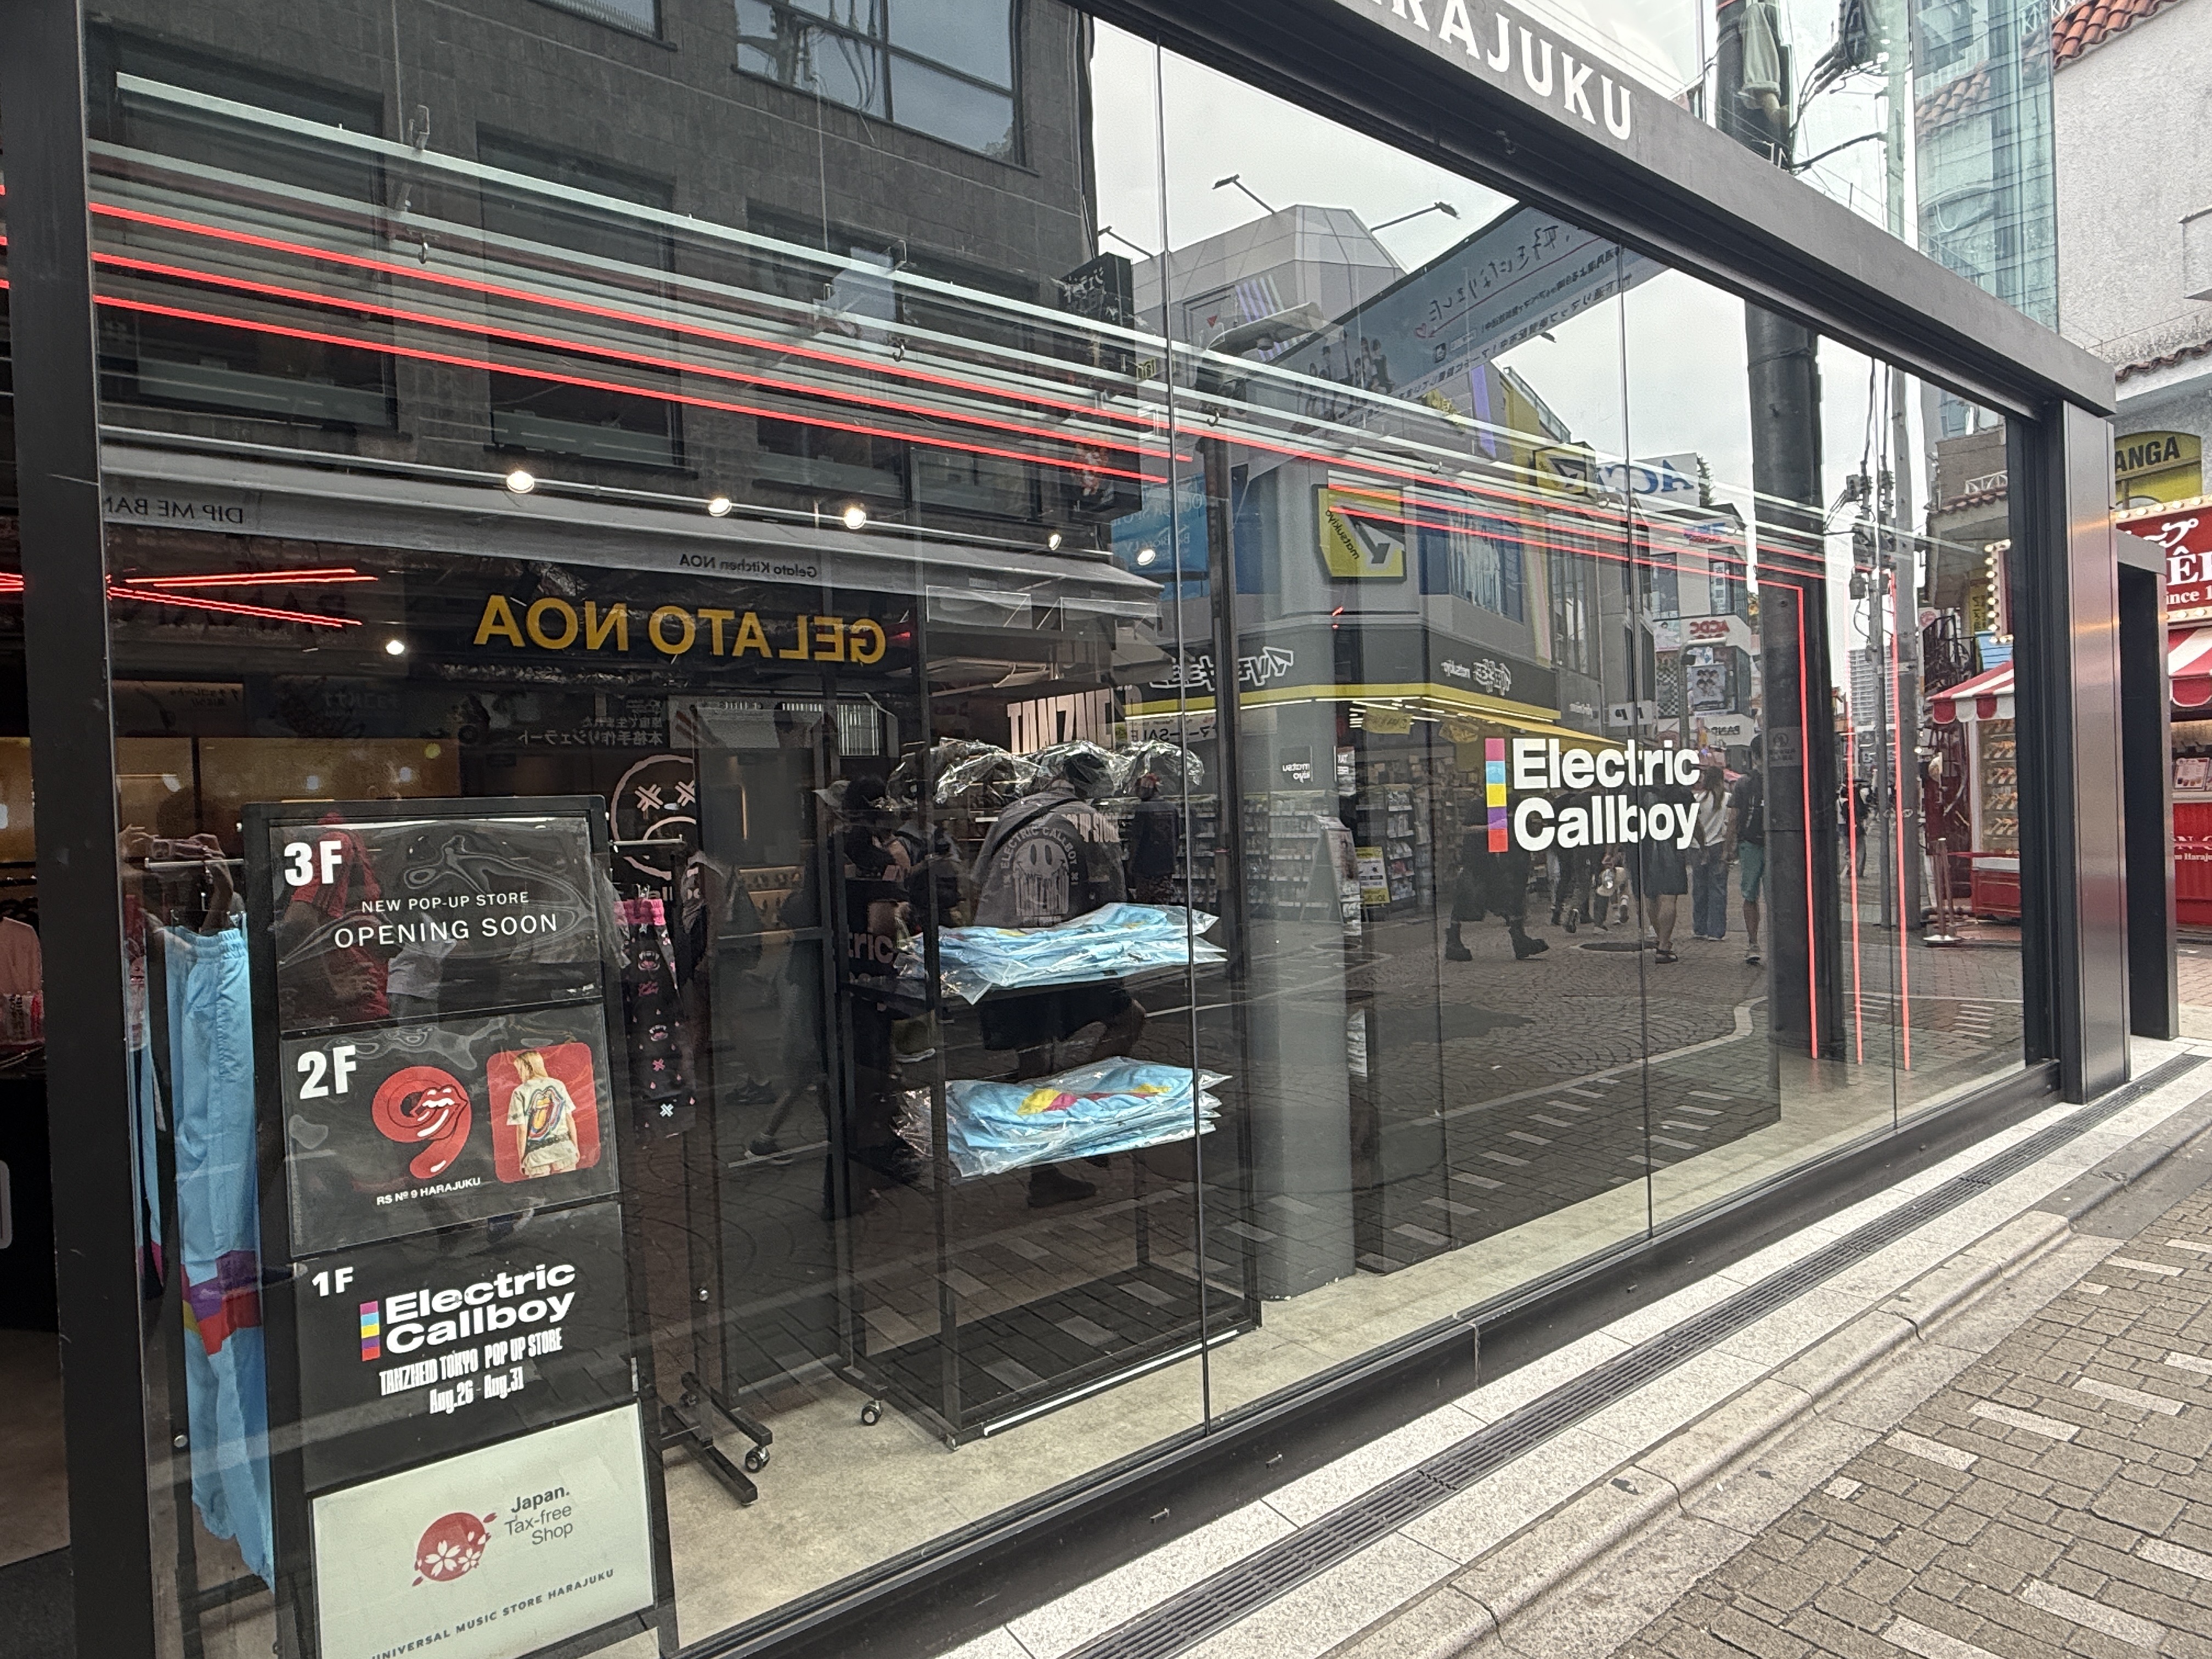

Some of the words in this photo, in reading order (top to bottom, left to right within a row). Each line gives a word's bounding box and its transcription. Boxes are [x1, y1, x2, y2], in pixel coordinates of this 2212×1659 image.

[2115, 437, 2180, 472] ANGA
[2166, 590, 2200, 605] ince
[1513, 738, 1701, 789] Electric
[1514, 794, 1701, 851] Callboy
[284, 840, 343, 886] 3F
[362, 899, 401, 913] NEW
[408, 895, 470, 911] POP-UP
[476, 891, 529, 907] STORE
[335, 919, 470, 948] OPENING
[481, 913, 557, 936] SOON
[297, 1045, 357, 1099] 2F
[376, 1194, 393, 1206] RS
[410, 1189, 418, 1199] 9
[420, 1177, 481, 1198] HARAJUKU
[312, 1266, 354, 1297] 1F
[385, 1263, 575, 1325] Electric
[386, 1291, 575, 1354] Callboy
[440, 1347, 478, 1375] TOKYO
[484, 1343, 508, 1370] POP
[510, 1338, 526, 1362] UP
[528, 1327, 563, 1357] STORE
[510, 1486, 571, 1514] Japan.
[504, 1503, 572, 1536] Tax-free
[532, 1520, 574, 1546] Shop
[455, 1611, 498, 1634] MUSIC
[502, 1594, 543, 1617] STORE
[548, 1567, 614, 1601] HARAJUKU
